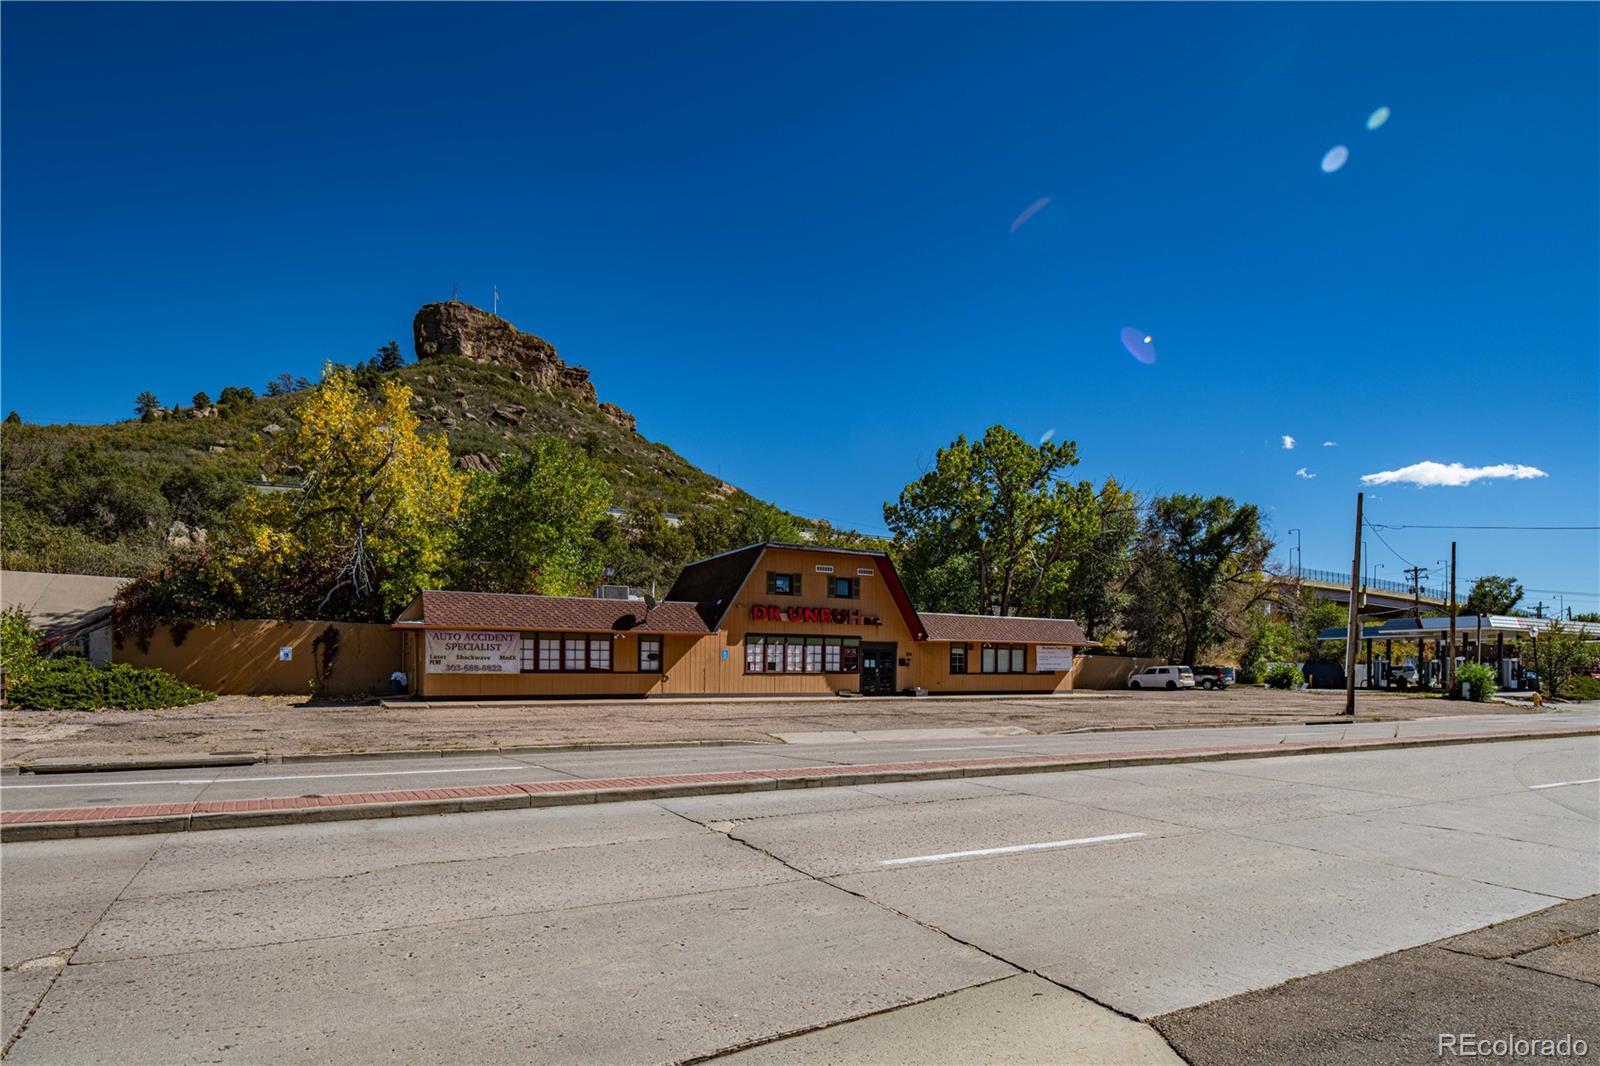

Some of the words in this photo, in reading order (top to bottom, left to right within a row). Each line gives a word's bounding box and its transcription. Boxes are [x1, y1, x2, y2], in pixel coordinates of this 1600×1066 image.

[751, 604, 781, 622] DR
[786, 606, 863, 625] UNRUH
[432, 632, 461, 641] AUTO
[463, 632, 514, 642] ACCIDENT
[445, 643, 502, 652] SPECIALIST
